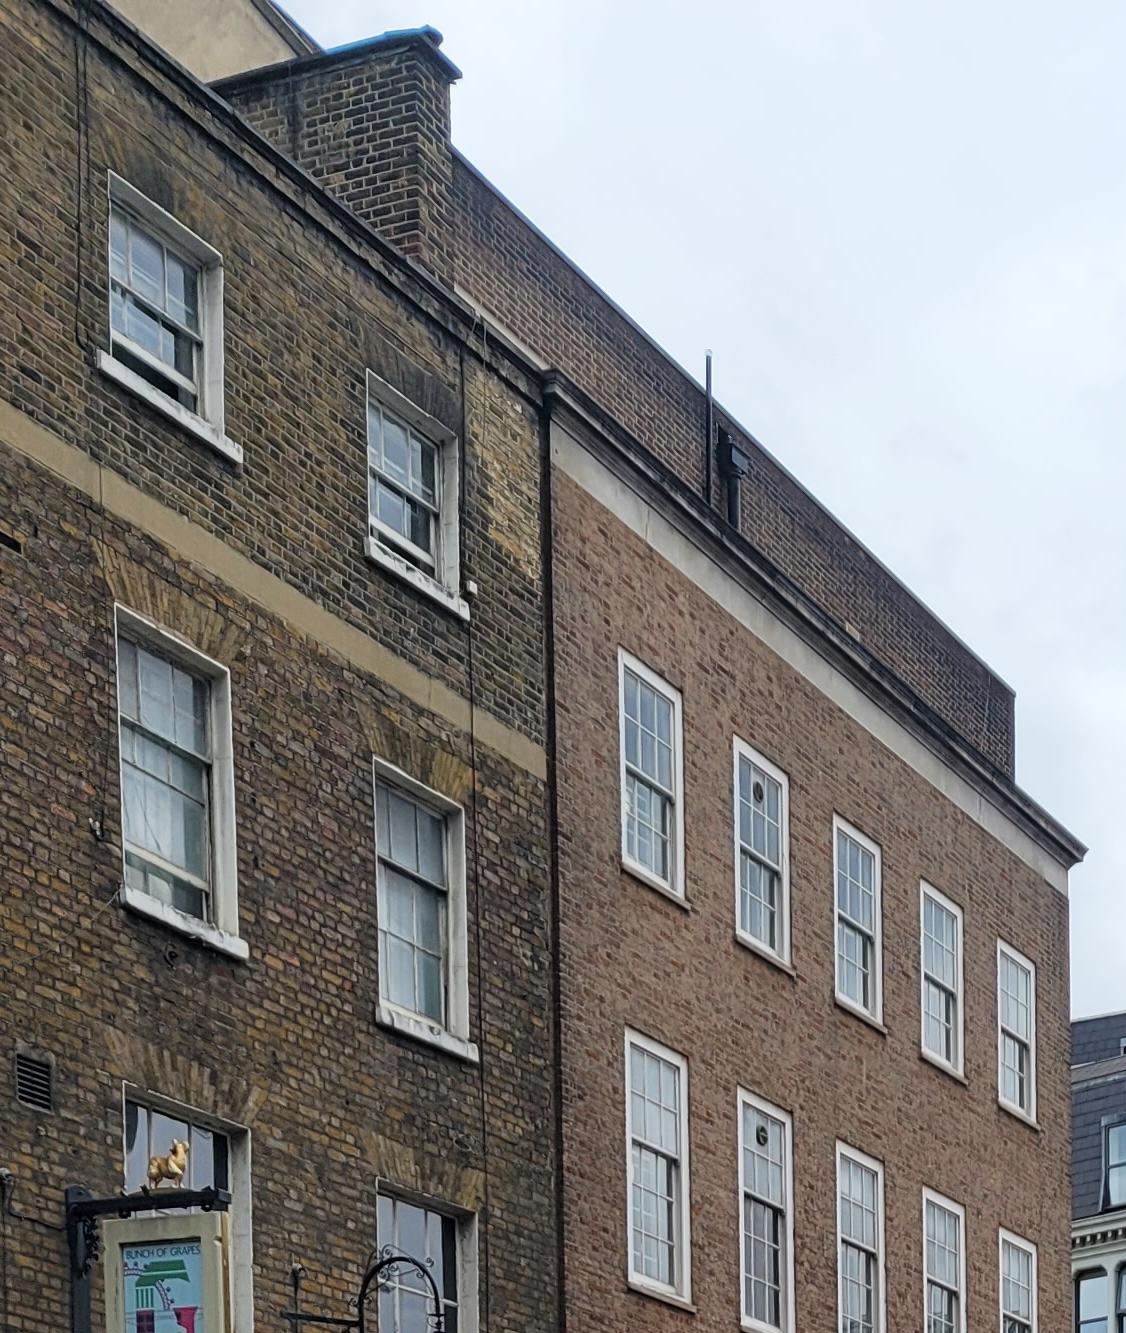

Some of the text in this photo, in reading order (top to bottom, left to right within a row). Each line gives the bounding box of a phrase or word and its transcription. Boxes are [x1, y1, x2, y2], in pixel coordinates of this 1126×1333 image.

[125, 1244, 201, 1260] BUNCH OF GRAPES
